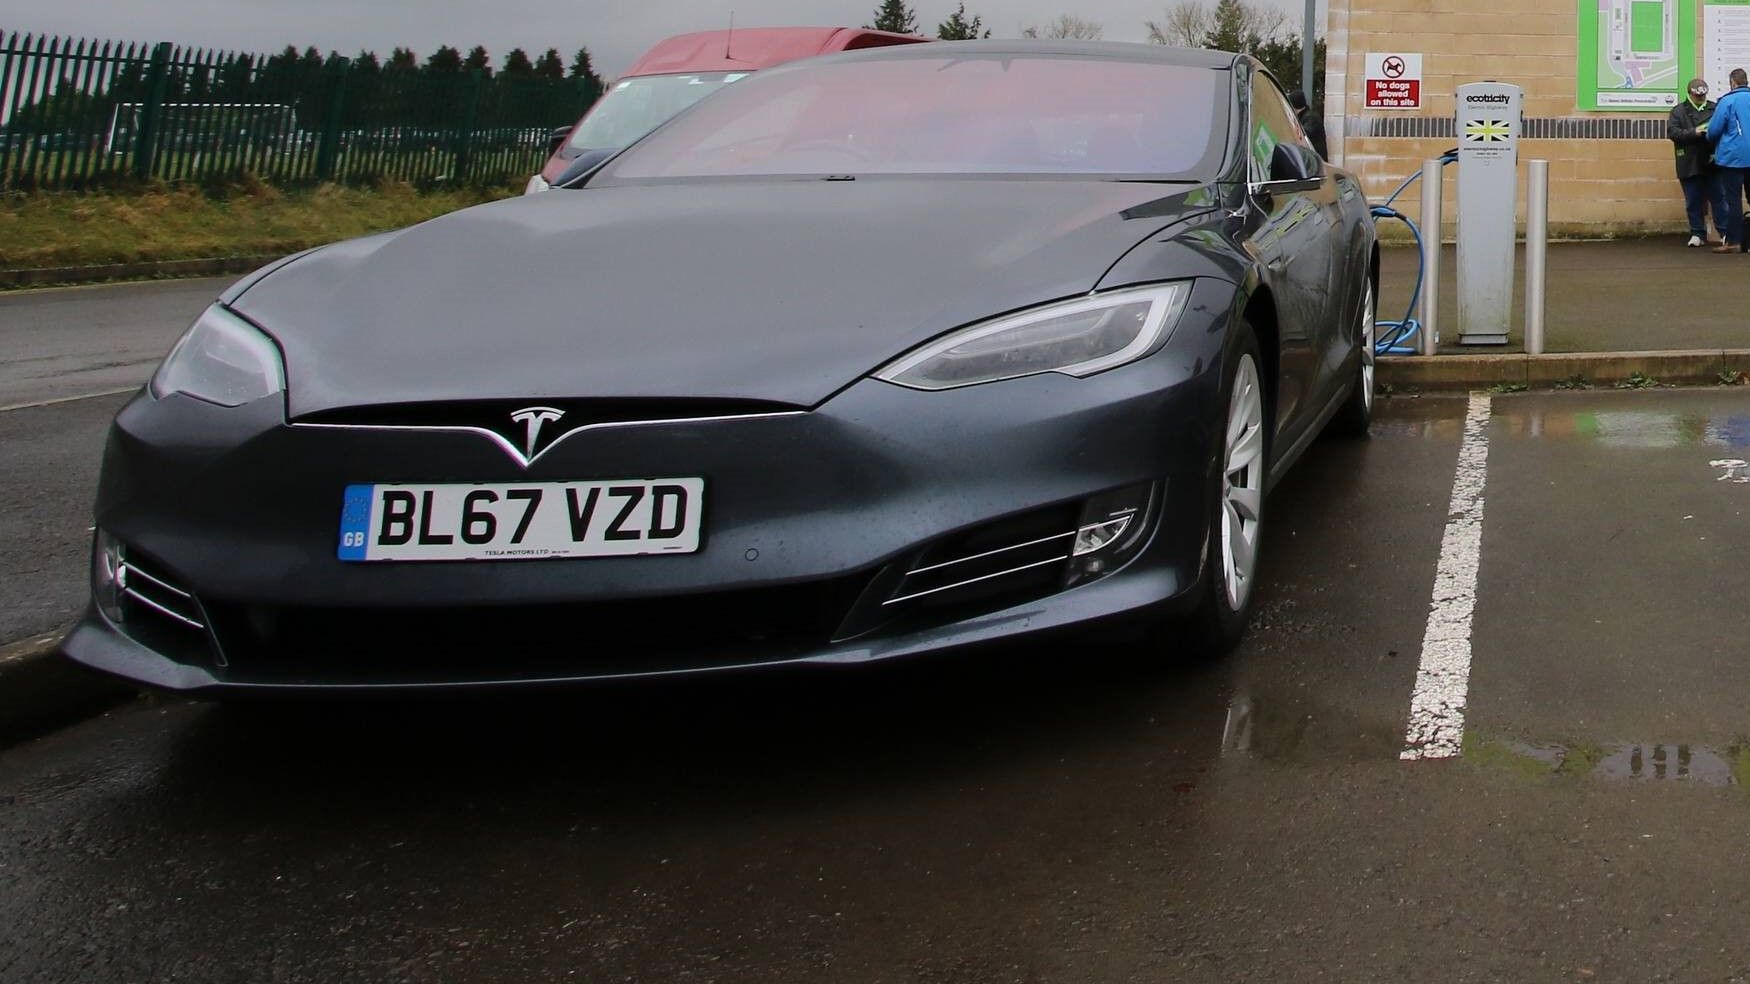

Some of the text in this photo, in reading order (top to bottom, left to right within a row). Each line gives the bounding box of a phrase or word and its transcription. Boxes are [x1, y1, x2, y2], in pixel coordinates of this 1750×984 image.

[1375, 81, 1410, 91] No dogs
[1383, 98, 1398, 106] this
[1400, 98, 1415, 106] site
[1466, 93, 1510, 104] ecotricity
[378, 484, 688, 546] BL67 VZD
[343, 531, 365, 547] GB
